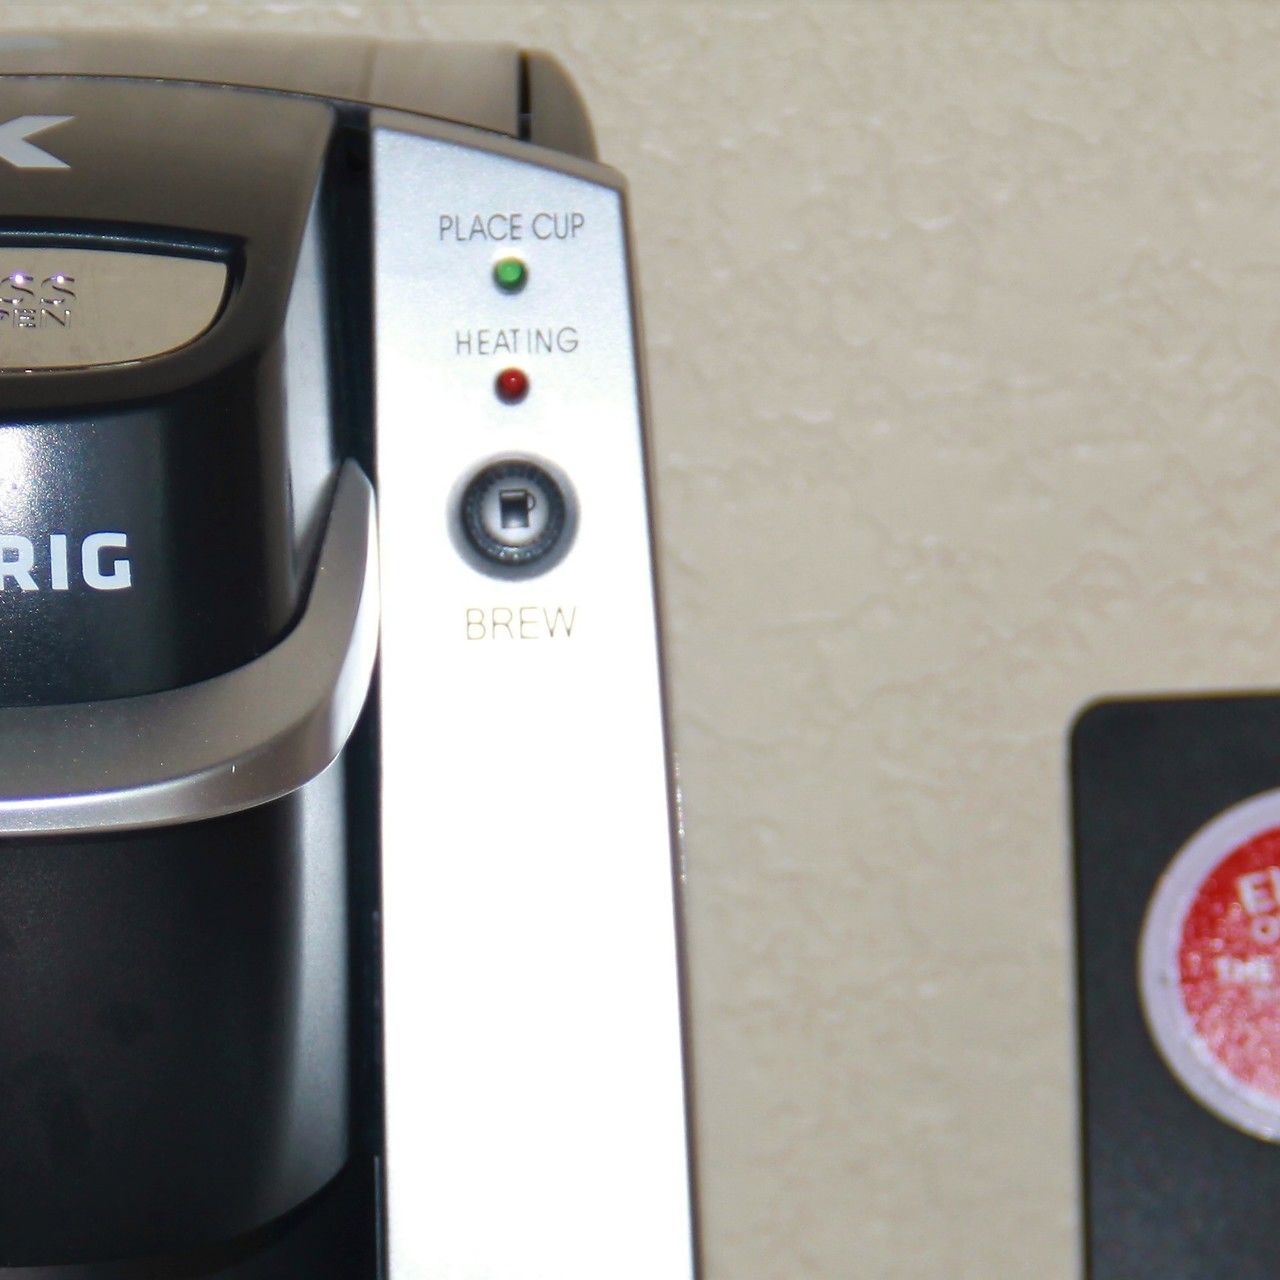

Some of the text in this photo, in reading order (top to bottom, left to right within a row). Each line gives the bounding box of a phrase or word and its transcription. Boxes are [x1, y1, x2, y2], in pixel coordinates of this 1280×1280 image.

[439, 211, 585, 242] PLACE CUP
[455, 326, 580, 356] HEATING
[465, 605, 578, 641] BREW
